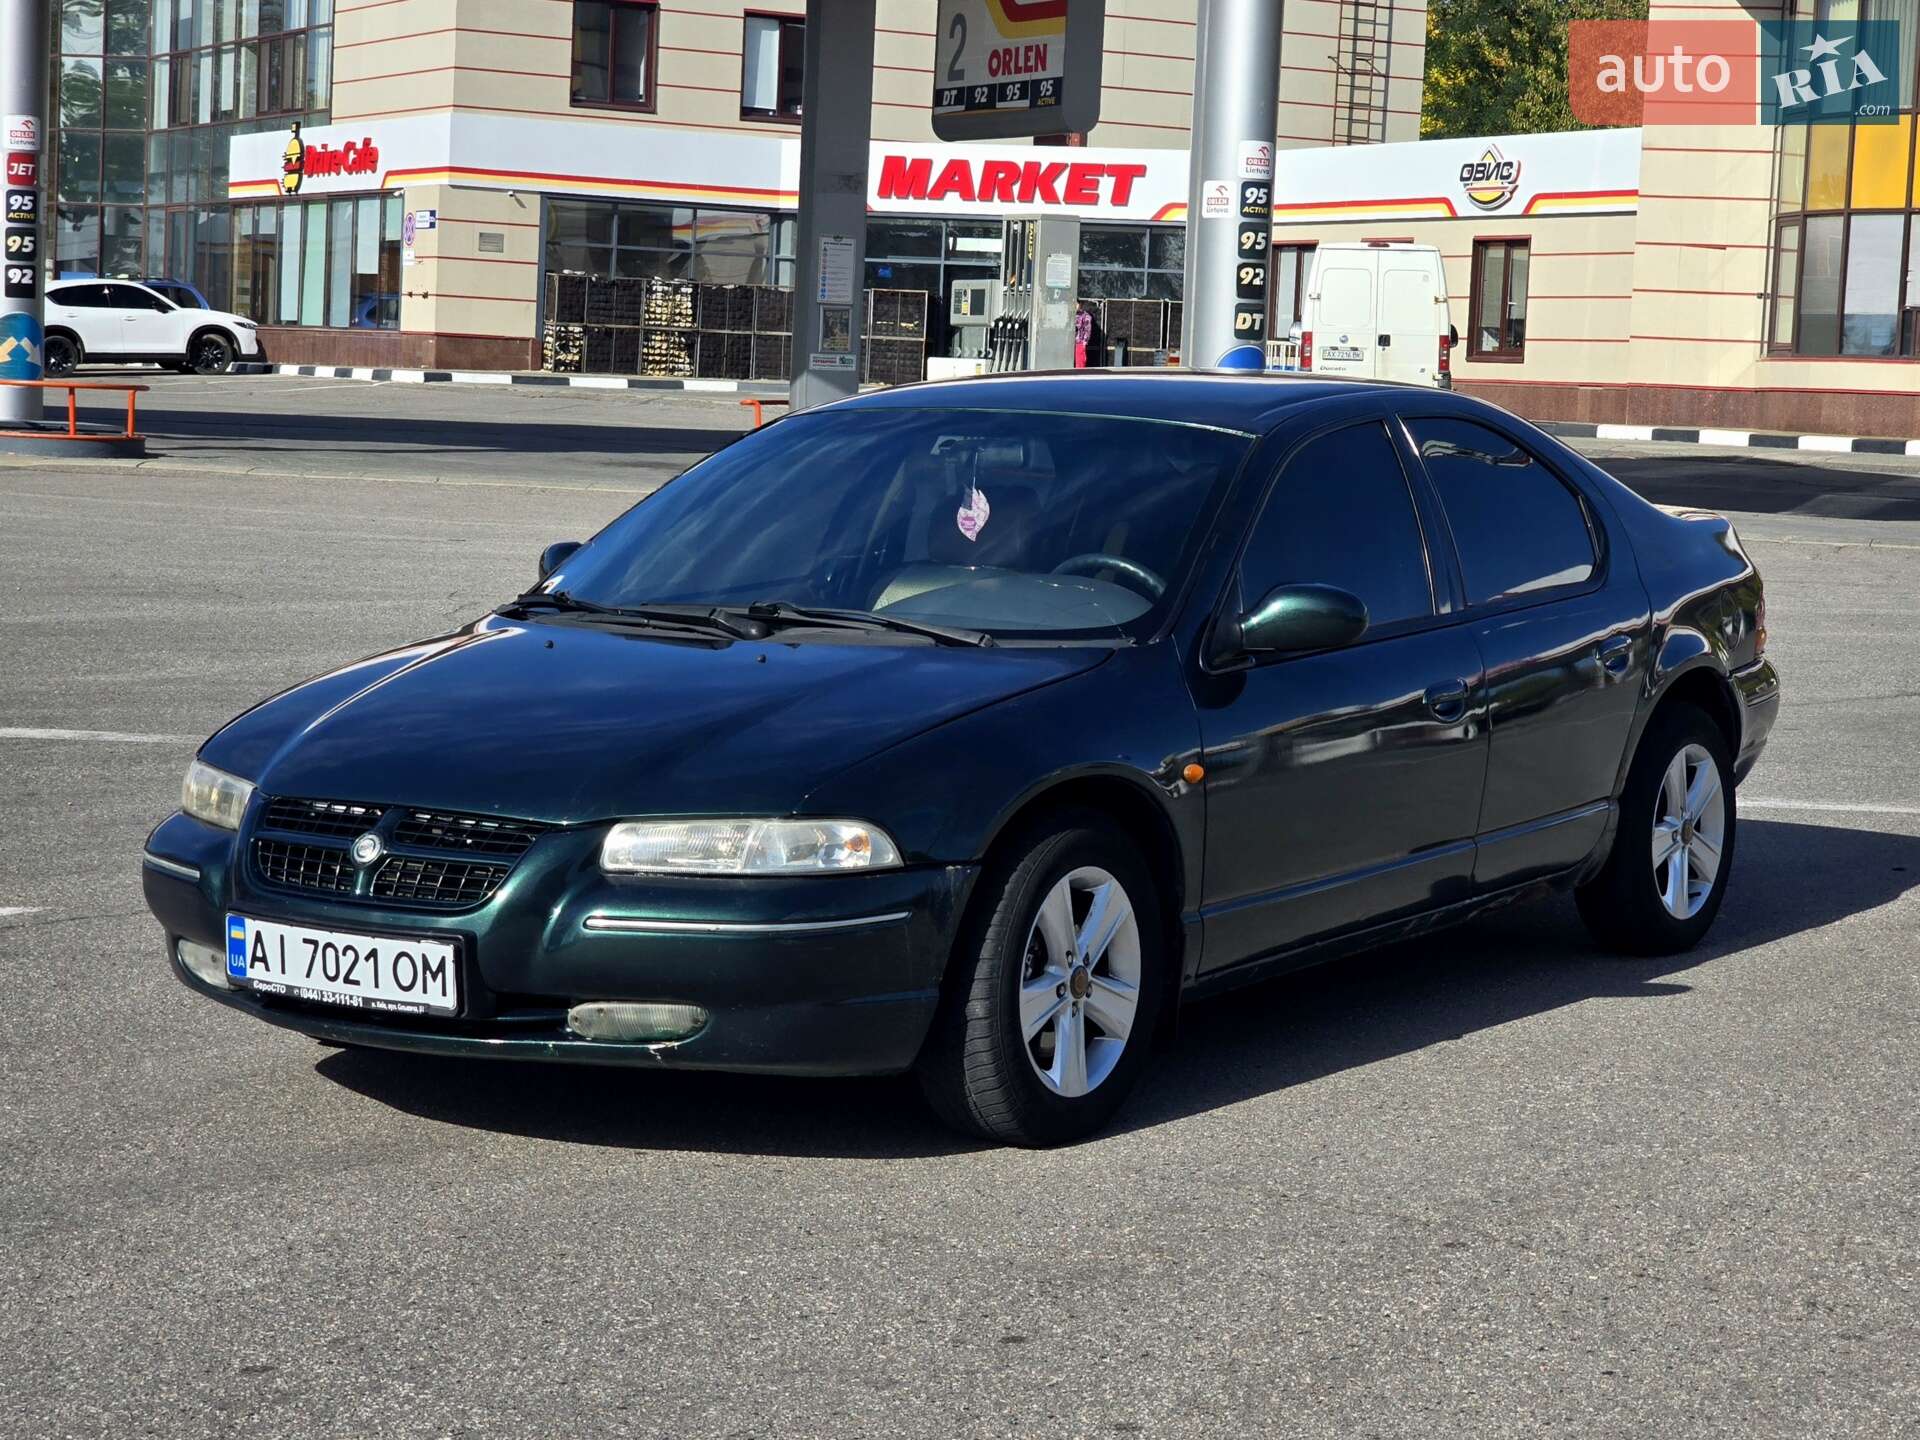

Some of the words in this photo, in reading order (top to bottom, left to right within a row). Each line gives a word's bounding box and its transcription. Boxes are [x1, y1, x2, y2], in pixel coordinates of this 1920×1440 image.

[947, 13, 967, 81] 2
[988, 43, 1048, 78] ORLEN
[942, 89, 958, 106] DT
[974, 86, 989, 104] 92
[1006, 83, 1021, 101] 95
[1040, 80, 1054, 97] 95
[10, 130, 34, 139] ORLEN
[8, 162, 36, 176] JET
[1247, 158, 1269, 166] ORLEN
[877, 155, 1147, 207] MARKET
[1459, 161, 1514, 183] ОВИС
[9, 195, 35, 211] 95
[1244, 187, 1269, 204] 95
[7, 235, 35, 253] 95
[1240, 231, 1267, 250] 95
[8, 267, 34, 284] 92
[1240, 266, 1265, 286] 92
[1235, 312, 1264, 331] DT
[231, 955, 245, 969] UA
[249, 930, 286, 975] AI
[302, 938, 380, 989] 7021
[392, 951, 448, 997] OM
[300, 988, 321, 1001] (044)
